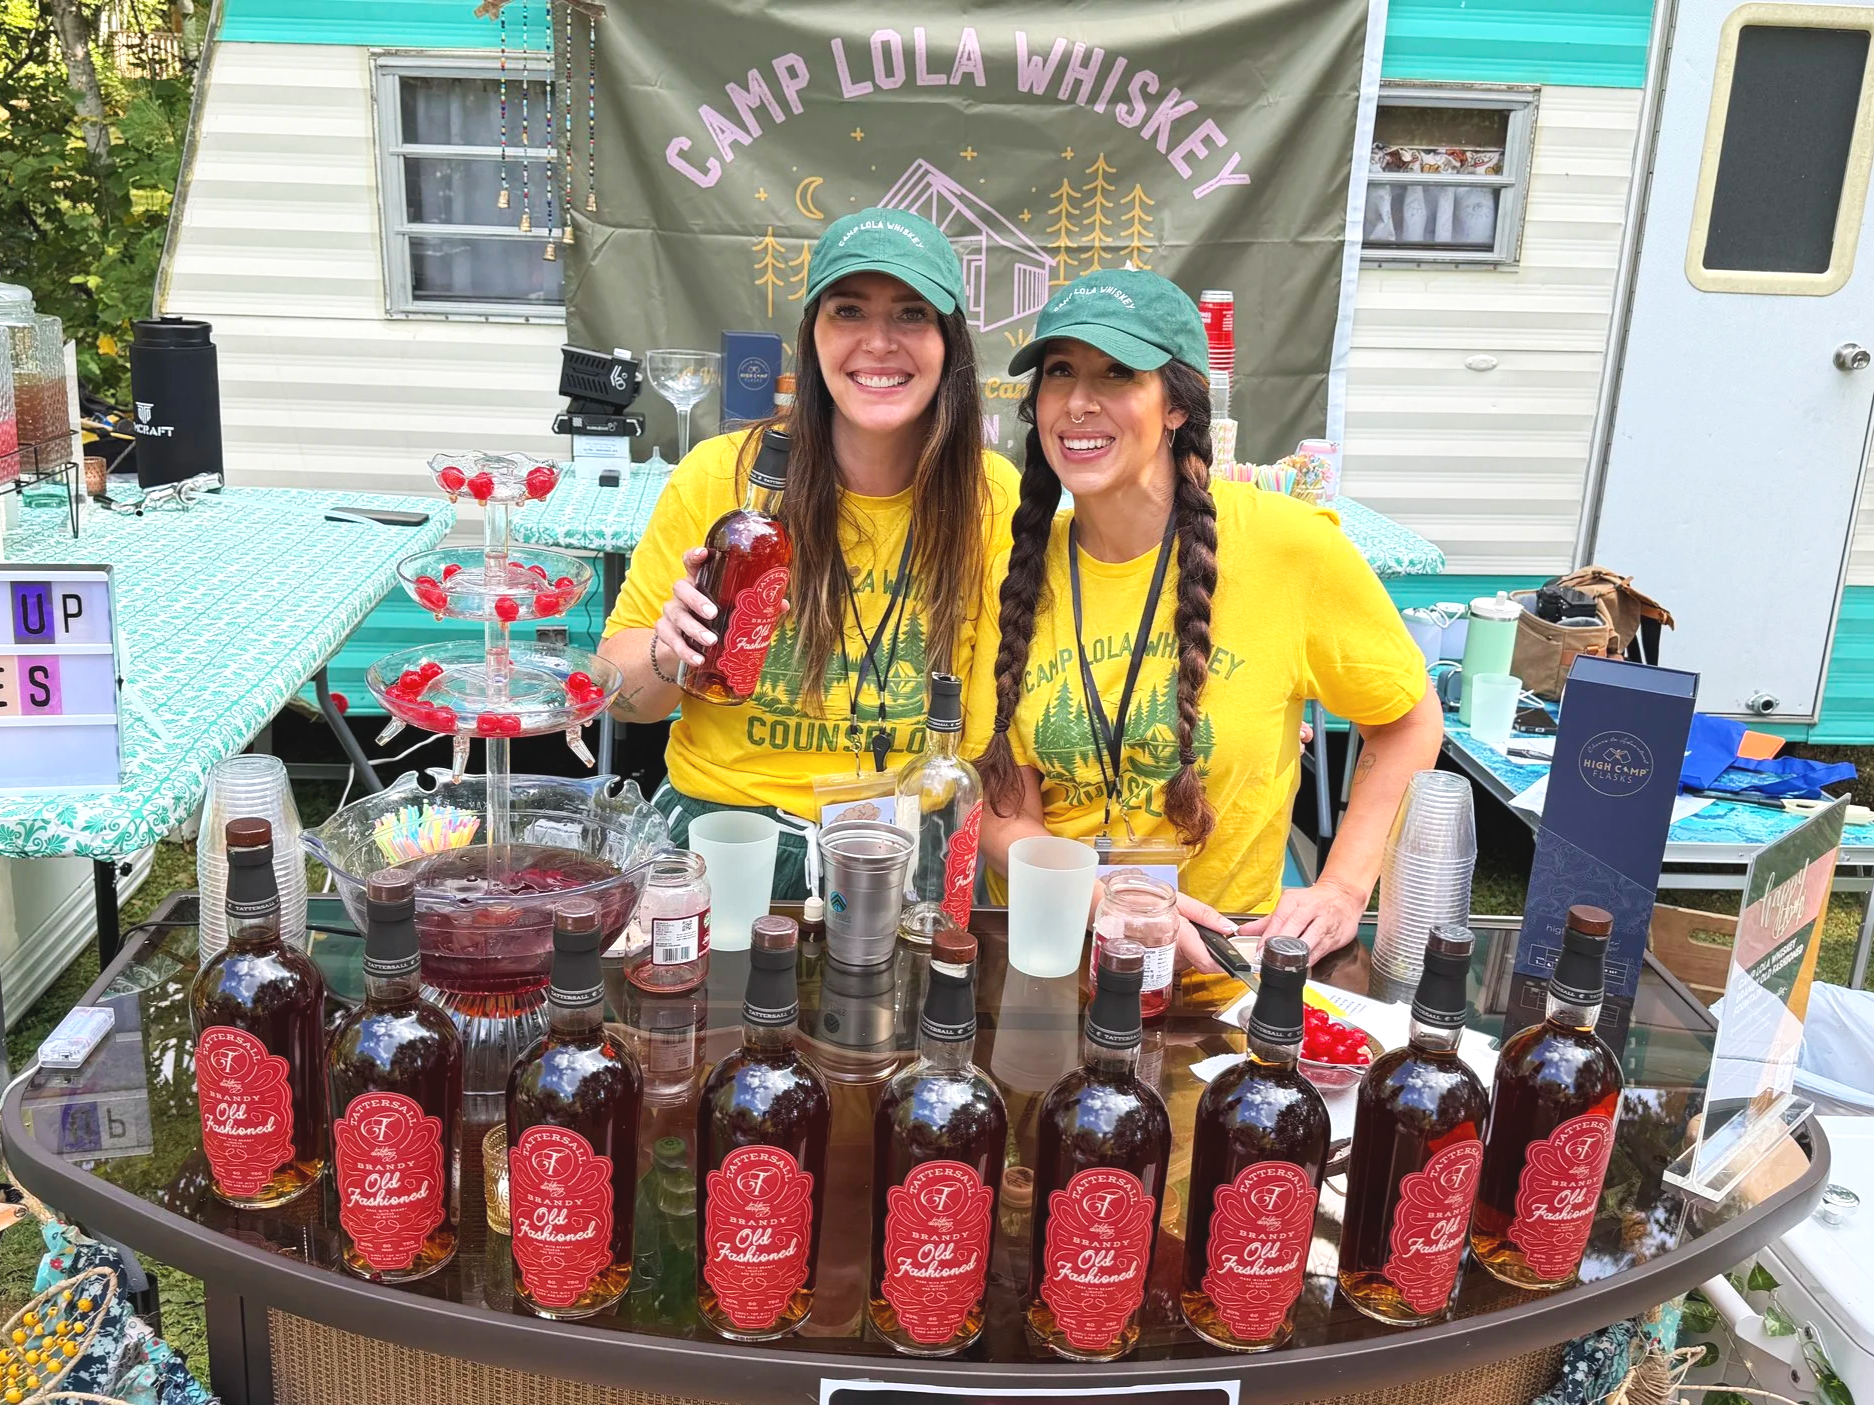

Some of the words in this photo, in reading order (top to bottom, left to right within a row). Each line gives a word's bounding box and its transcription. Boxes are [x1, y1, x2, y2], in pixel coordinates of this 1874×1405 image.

[665, 52, 810, 188] CAMP
[830, 26, 987, 99] LOLA
[1014, 30, 1251, 200] WHISKEY
[838, 226, 859, 247] CAMP
[860, 220, 884, 230] LOLA
[886, 221, 925, 249] WHISKEY
[1074, 286, 1097, 295] LOLA
[1100, 285, 1136, 310] WHISKEY
[21, 593, 83, 635] UP
[751, 624, 771, 640] Old
[1024, 648, 1073, 694] CAMP
[1144, 631, 1246, 681] WHEY
[747, 715, 929, 754] COUNSELO
[1583, 759, 1612, 771] HIGH
[1592, 770, 1632, 784] FLASKS
[203, 1033, 261, 1063] TATTERSALL
[209, 1090, 262, 1102] BRANDY
[216, 1102, 248, 1121] Old
[350, 1100, 419, 1127] TATTERSALL
[204, 1113, 277, 1136] Fashioned
[523, 1133, 587, 1164] TATTERSALL
[357, 1160, 416, 1171] BRANDY
[726, 1153, 793, 1182] TATTERSALL
[347, 1180, 429, 1207] Fashioned
[365, 1172, 401, 1193] Old
[909, 1168, 976, 1197] TATTERSALL
[1072, 1175, 1139, 1205] TATTERSALL
[1239, 1168, 1305, 1197] TATTERSALL
[1551, 1176, 1599, 1188] BRANDY
[527, 1193, 584, 1206] BRANDY
[1554, 1187, 1586, 1208] Old
[533, 1207, 568, 1226] Old
[729, 1216, 788, 1226] BRANDY
[1427, 1203, 1470, 1219] BRANDY
[518, 1218, 596, 1242] Fashioned
[736, 1227, 772, 1248] Old
[911, 1231, 970, 1241] BRANDY
[1238, 1229, 1295, 1240] BRANDY
[1430, 1215, 1460, 1240] Old
[714, 1237, 798, 1263] Fashioned
[918, 1242, 955, 1263] Old
[1073, 1236, 1130, 1248] BRANDY
[1243, 1241, 1280, 1261] Old
[894, 1251, 978, 1278] Fashioned
[1078, 1249, 1115, 1269] Old
[1217, 1251, 1300, 1276] Fashioned
[1053, 1261, 1137, 1284] Fashioned
